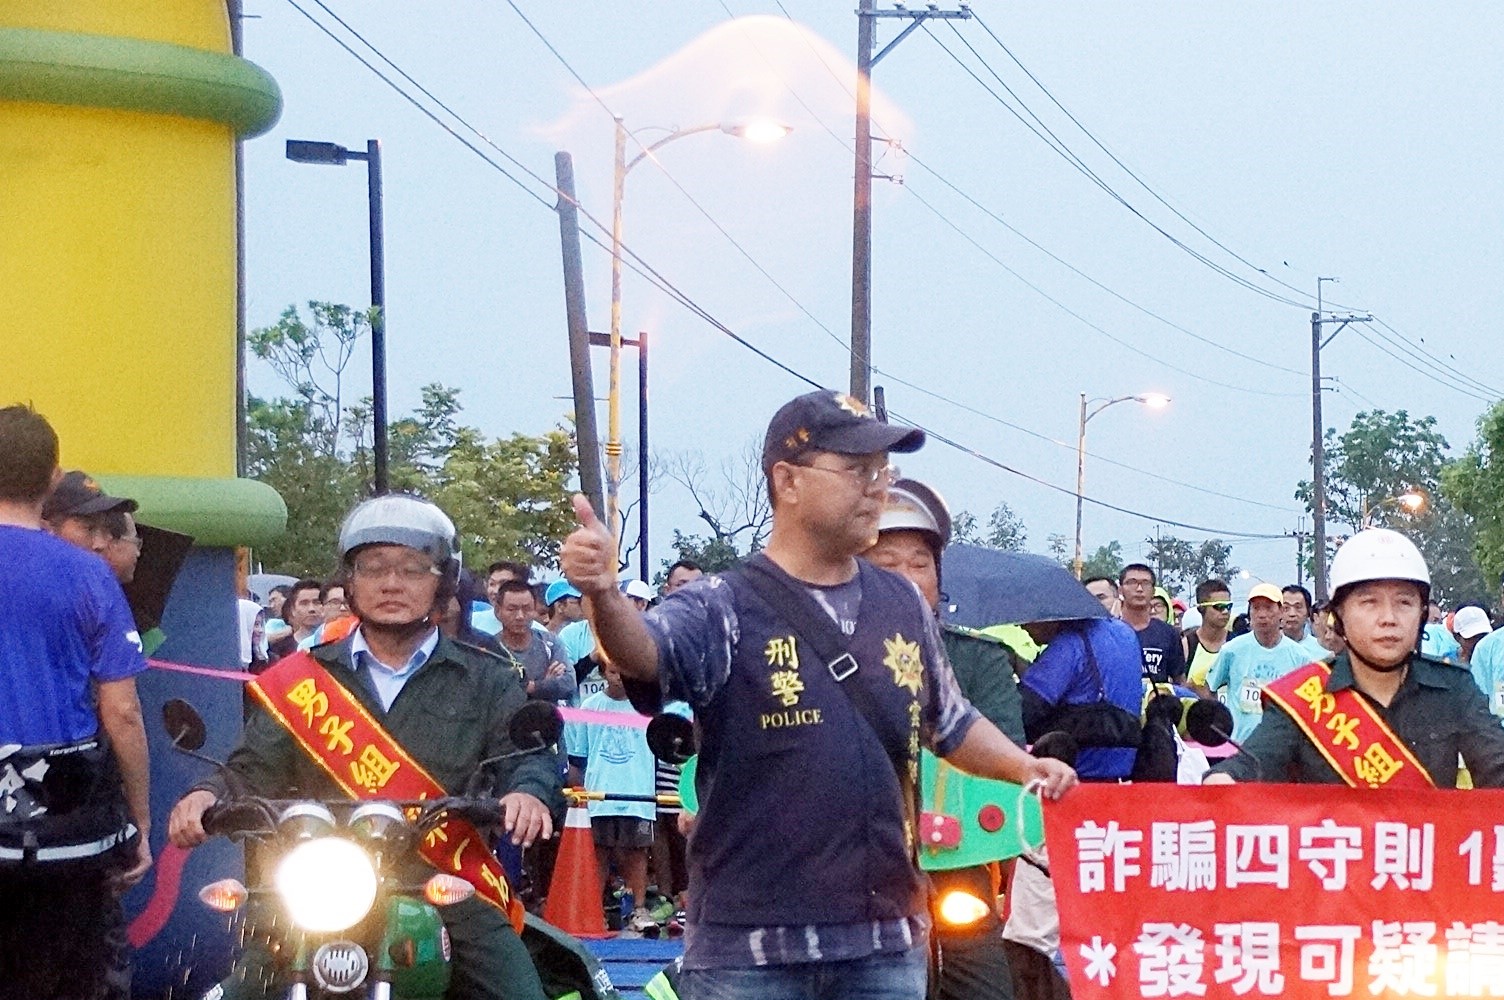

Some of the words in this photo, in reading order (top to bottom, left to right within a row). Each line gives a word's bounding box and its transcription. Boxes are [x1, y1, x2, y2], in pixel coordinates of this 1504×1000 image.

[764, 635, 805, 707] 刑警
[287, 677, 401, 793] 男子組
[761, 709, 824, 729] POLICE
[1294, 675, 1404, 789] 男子組
[1075, 819, 1436, 894] 詐騙四守則
